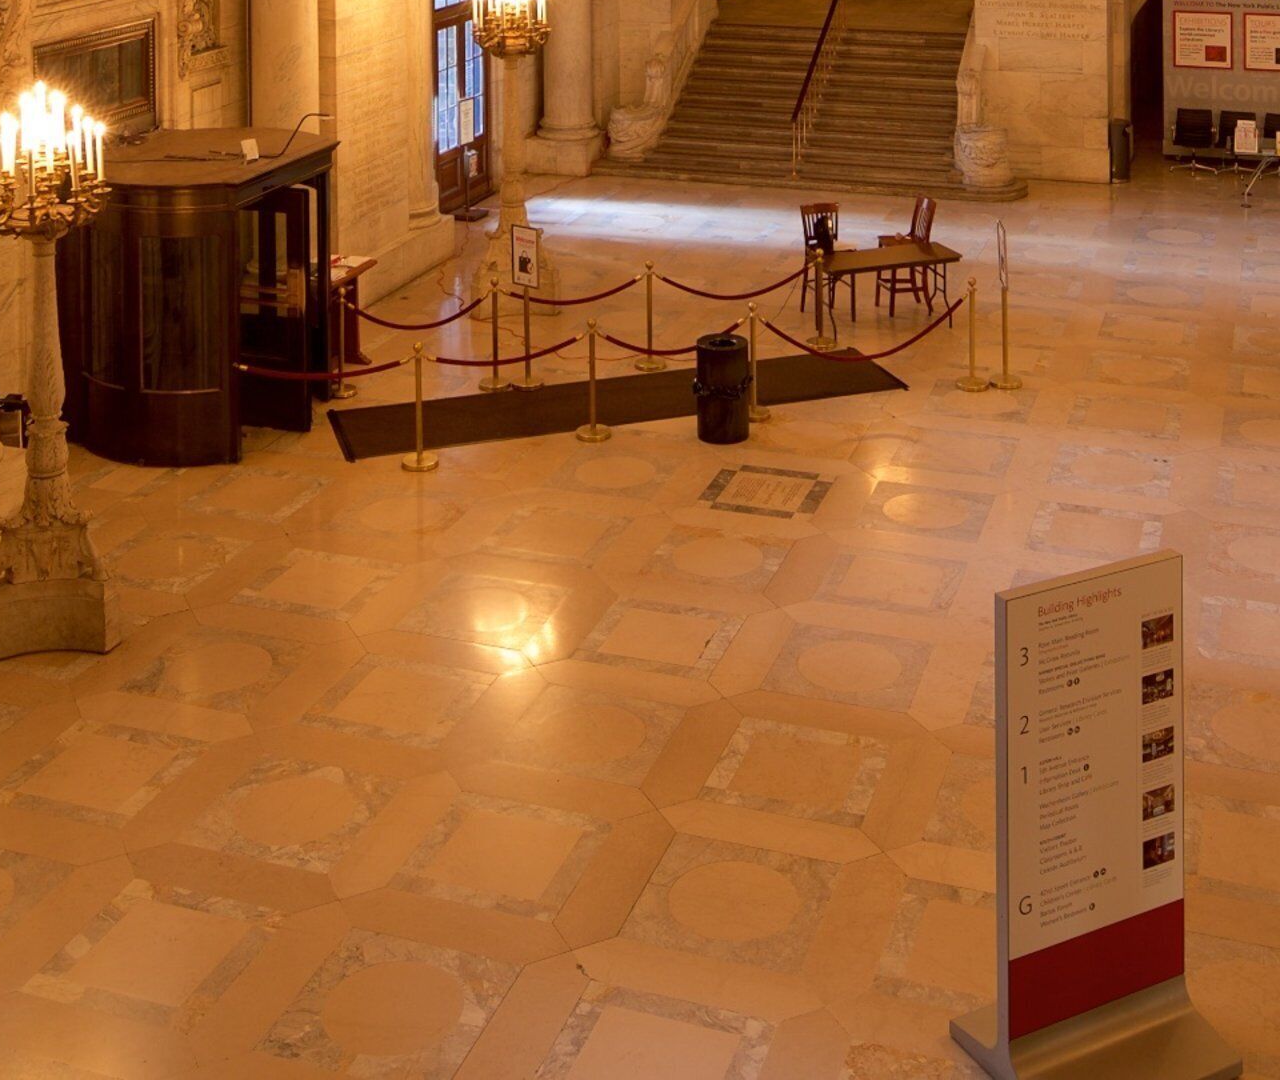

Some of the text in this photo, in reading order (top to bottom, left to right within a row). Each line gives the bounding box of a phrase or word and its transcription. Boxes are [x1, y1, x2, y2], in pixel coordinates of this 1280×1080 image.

[1038, 587, 1122, 617] Building Highlights
[1020, 647, 1029, 667] 3
[1020, 715, 1029, 735] 2
[1020, 766, 1027, 785] 1
[1018, 895, 1032, 915] G
